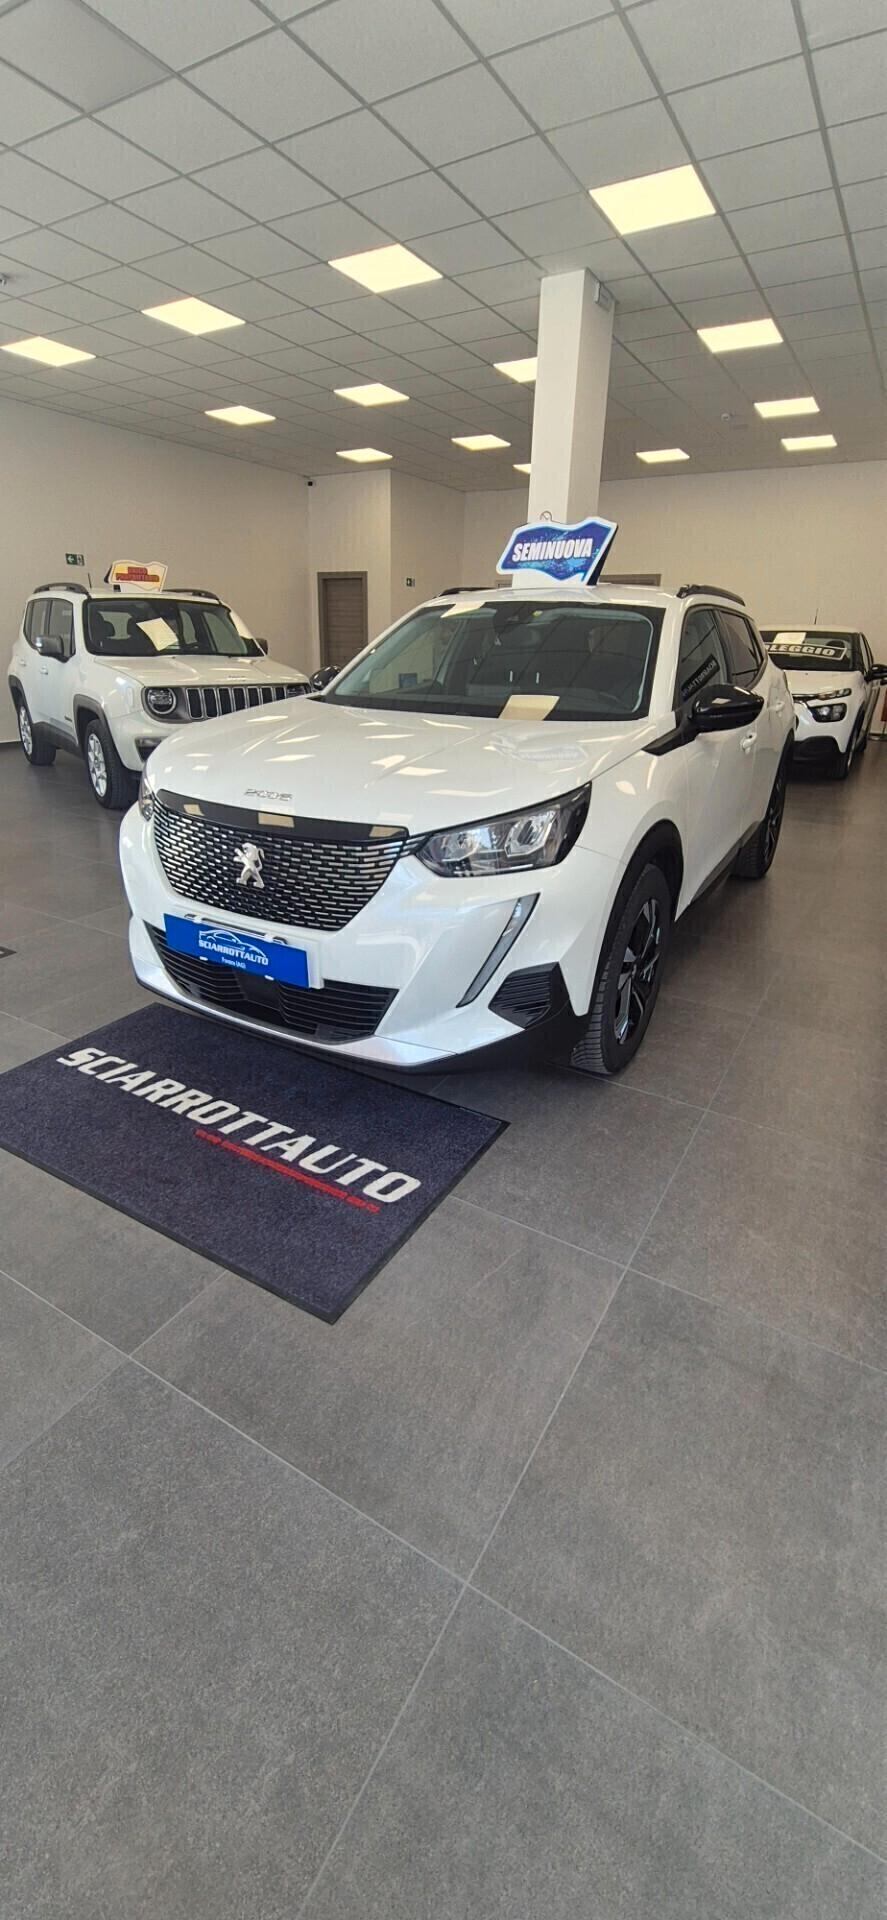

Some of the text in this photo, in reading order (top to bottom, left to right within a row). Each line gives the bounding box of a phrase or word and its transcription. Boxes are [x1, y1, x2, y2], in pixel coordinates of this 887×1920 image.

[512, 538, 593, 562] SEMINUOVA
[198, 940, 269, 966] SCIARROTTAUTO
[56, 1047, 421, 1203] SCIARROTTAUTO
